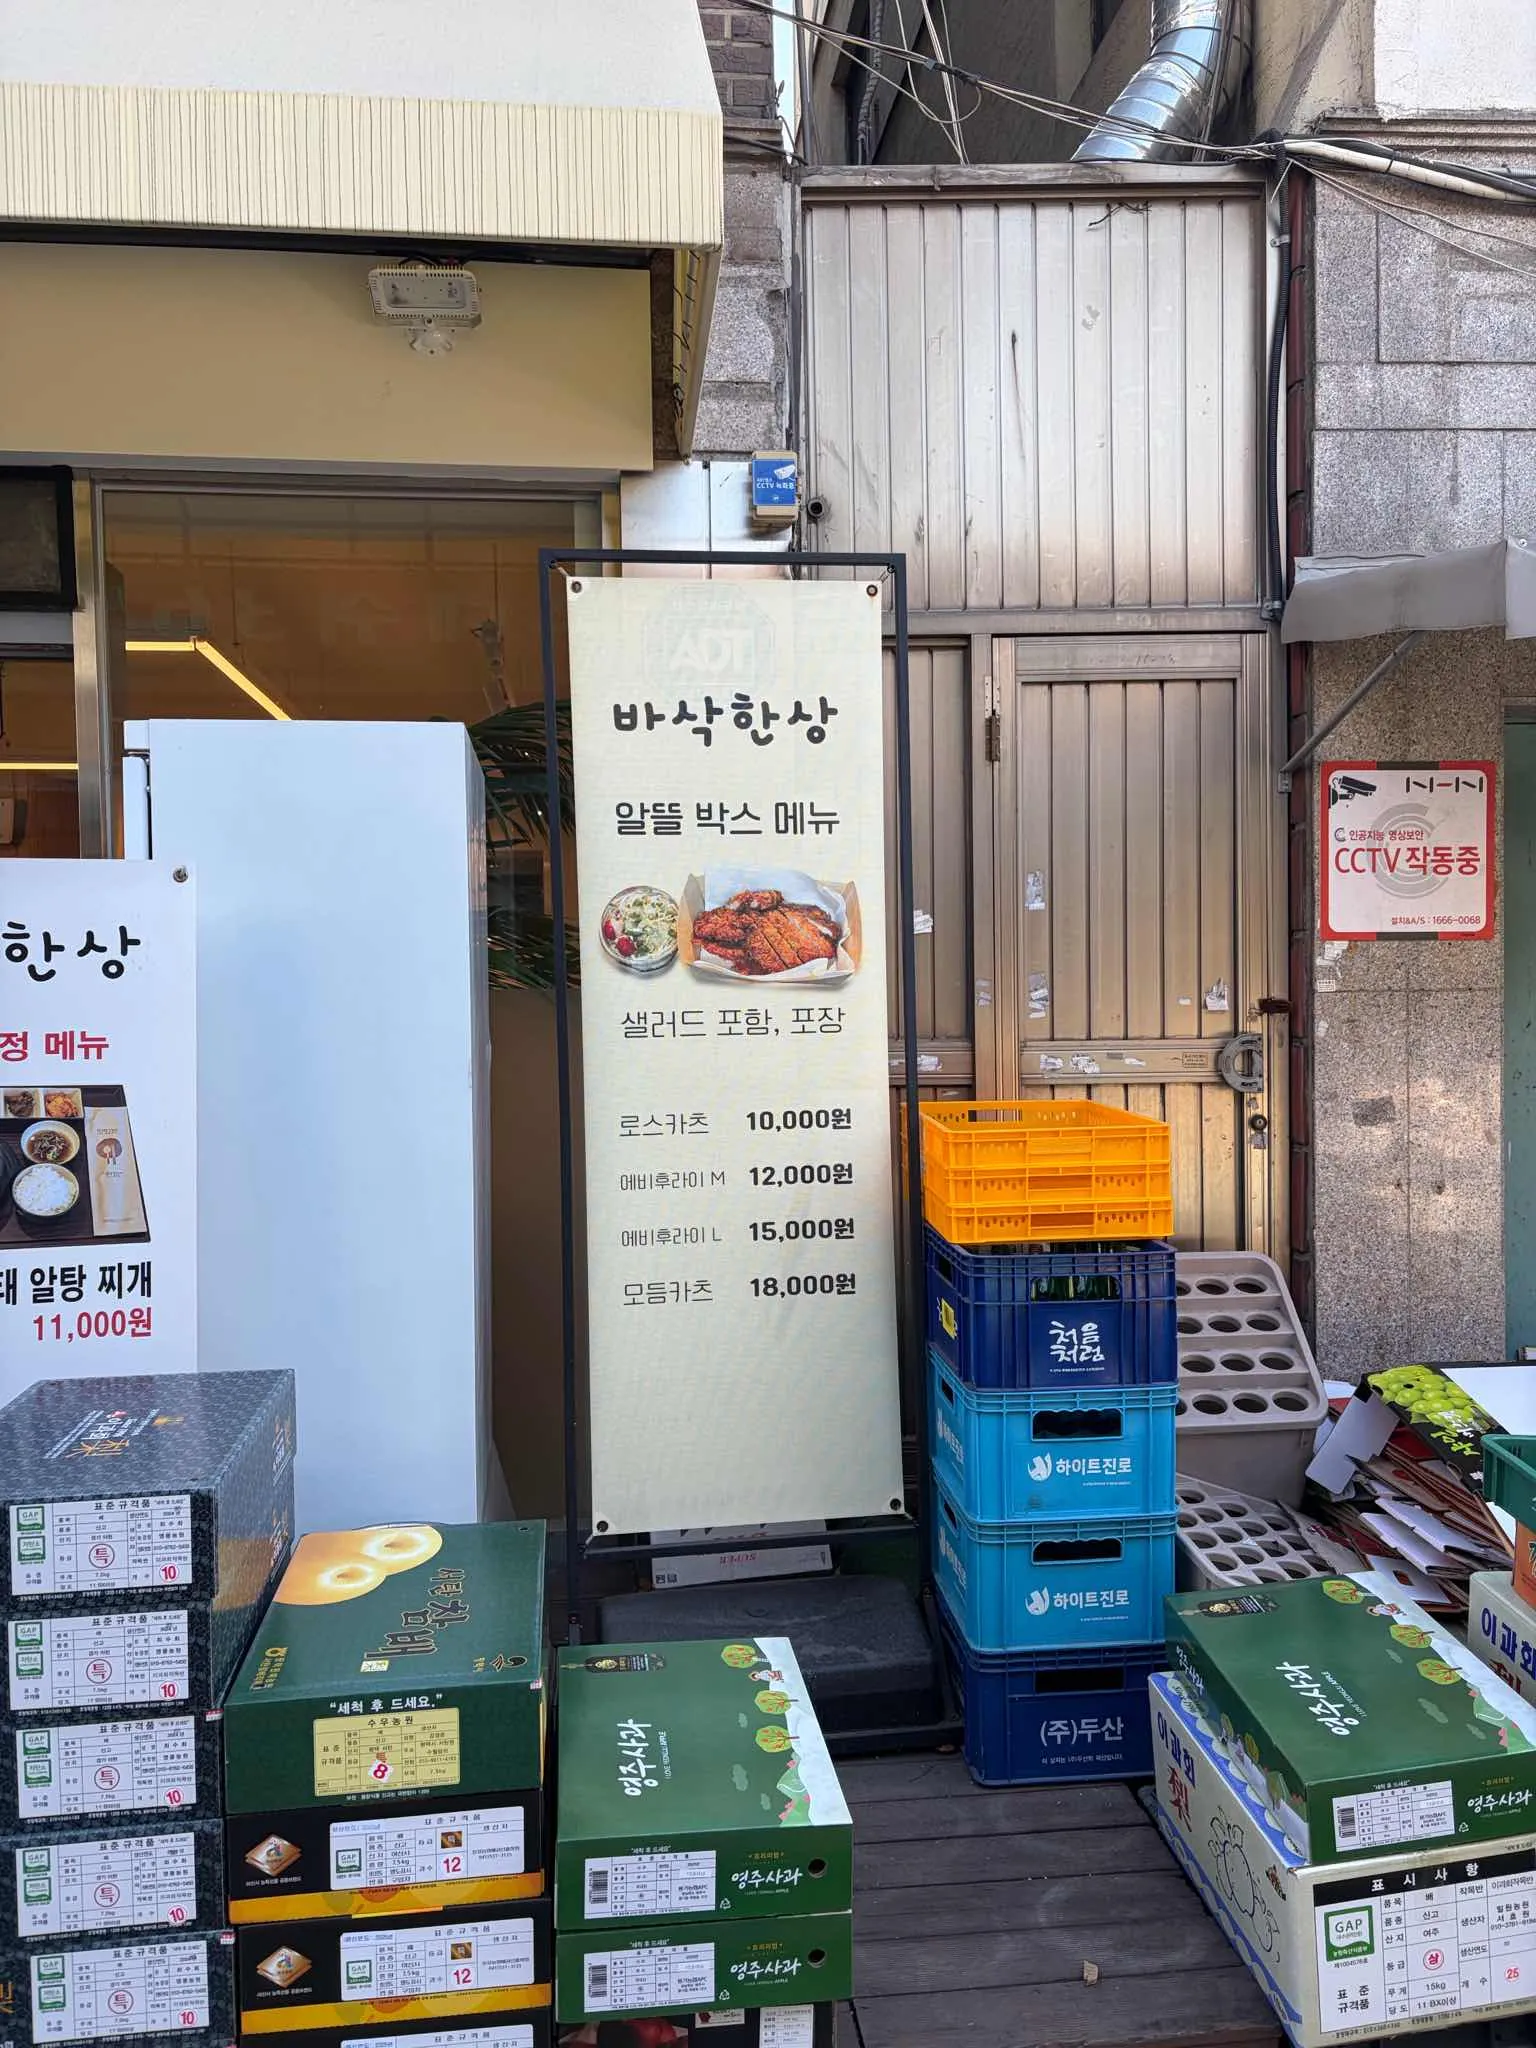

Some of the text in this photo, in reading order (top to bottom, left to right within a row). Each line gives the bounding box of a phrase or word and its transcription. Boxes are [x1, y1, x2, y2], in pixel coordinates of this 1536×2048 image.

[613, 692, 838, 747] 바삭한상
[616, 801, 840, 836] 알뜰 박스 메뉴
[1349, 830, 1424, 841] 인공지능 영상보안
[1335, 846, 1480, 876] CCTV 작동중
[1432, 915, 1480, 925] 1666-0068
[2, 921, 141, 982] 한상
[621, 1006, 846, 1039] 샐러드 포함, 포장
[45, 1030, 109, 1061] 메뉴
[619, 1108, 852, 1137] 로스카츠 10,000원
[620, 1163, 853, 1191] 에비후라이 M 12,000원
[621, 1218, 855, 1247] 에비후라이 L 15,000원
[30, 1264, 87, 1304] 알탕
[98, 1261, 152, 1299] 찌개
[623, 1273, 856, 1306] 모듬카츠 18,000원
[33, 1307, 152, 1343] 11,000원
[1049, 1321, 1099, 1345] 처음
[1050, 1345, 1105, 1364] 처럼
[1056, 1458, 1132, 1476] 하이트진로
[94, 1499, 150, 1510] 표준규격품
[94, 1548, 110, 1564] 특
[161, 1565, 176, 1579] 10
[1053, 1590, 1130, 1611] 하이트진로
[92, 1615, 147, 1626] 표준규격품
[91, 1663, 107, 1679] 특
[160, 1684, 176, 1697] 10
[1275, 1660, 1361, 1736] 영주사과
[371, 1699, 383, 1712] 후
[99, 1722, 154, 1734] 표준규격품
[1040, 1716, 1124, 1746] (주)두산
[616, 1718, 659, 1797] 영주사과
[99, 1770, 115, 1786] 특
[373, 1763, 388, 1779] 8
[166, 1790, 182, 1804] 10
[1467, 1789, 1533, 1813] 영주사과
[100, 1839, 154, 1850] 표준규격품
[443, 1856, 461, 1873] 12
[731, 1868, 803, 1889] 영주사과
[99, 1887, 115, 1903] 특
[169, 1908, 184, 1921] 10
[1423, 1911, 1439, 1920] 신고
[1335, 1919, 1362, 1933] GAP
[1423, 1929, 1440, 1937] 여주
[453, 1968, 472, 1984] 12
[730, 1957, 802, 1981] 영주사과
[1507, 1968, 1519, 1979] 25
[1337, 1985, 1369, 1999] 표준
[1426, 1983, 1446, 1991] 15kg
[113, 1993, 128, 2009] 특
[1338, 1999, 1369, 2013] 규격품
[180, 2011, 194, 2025] 10
